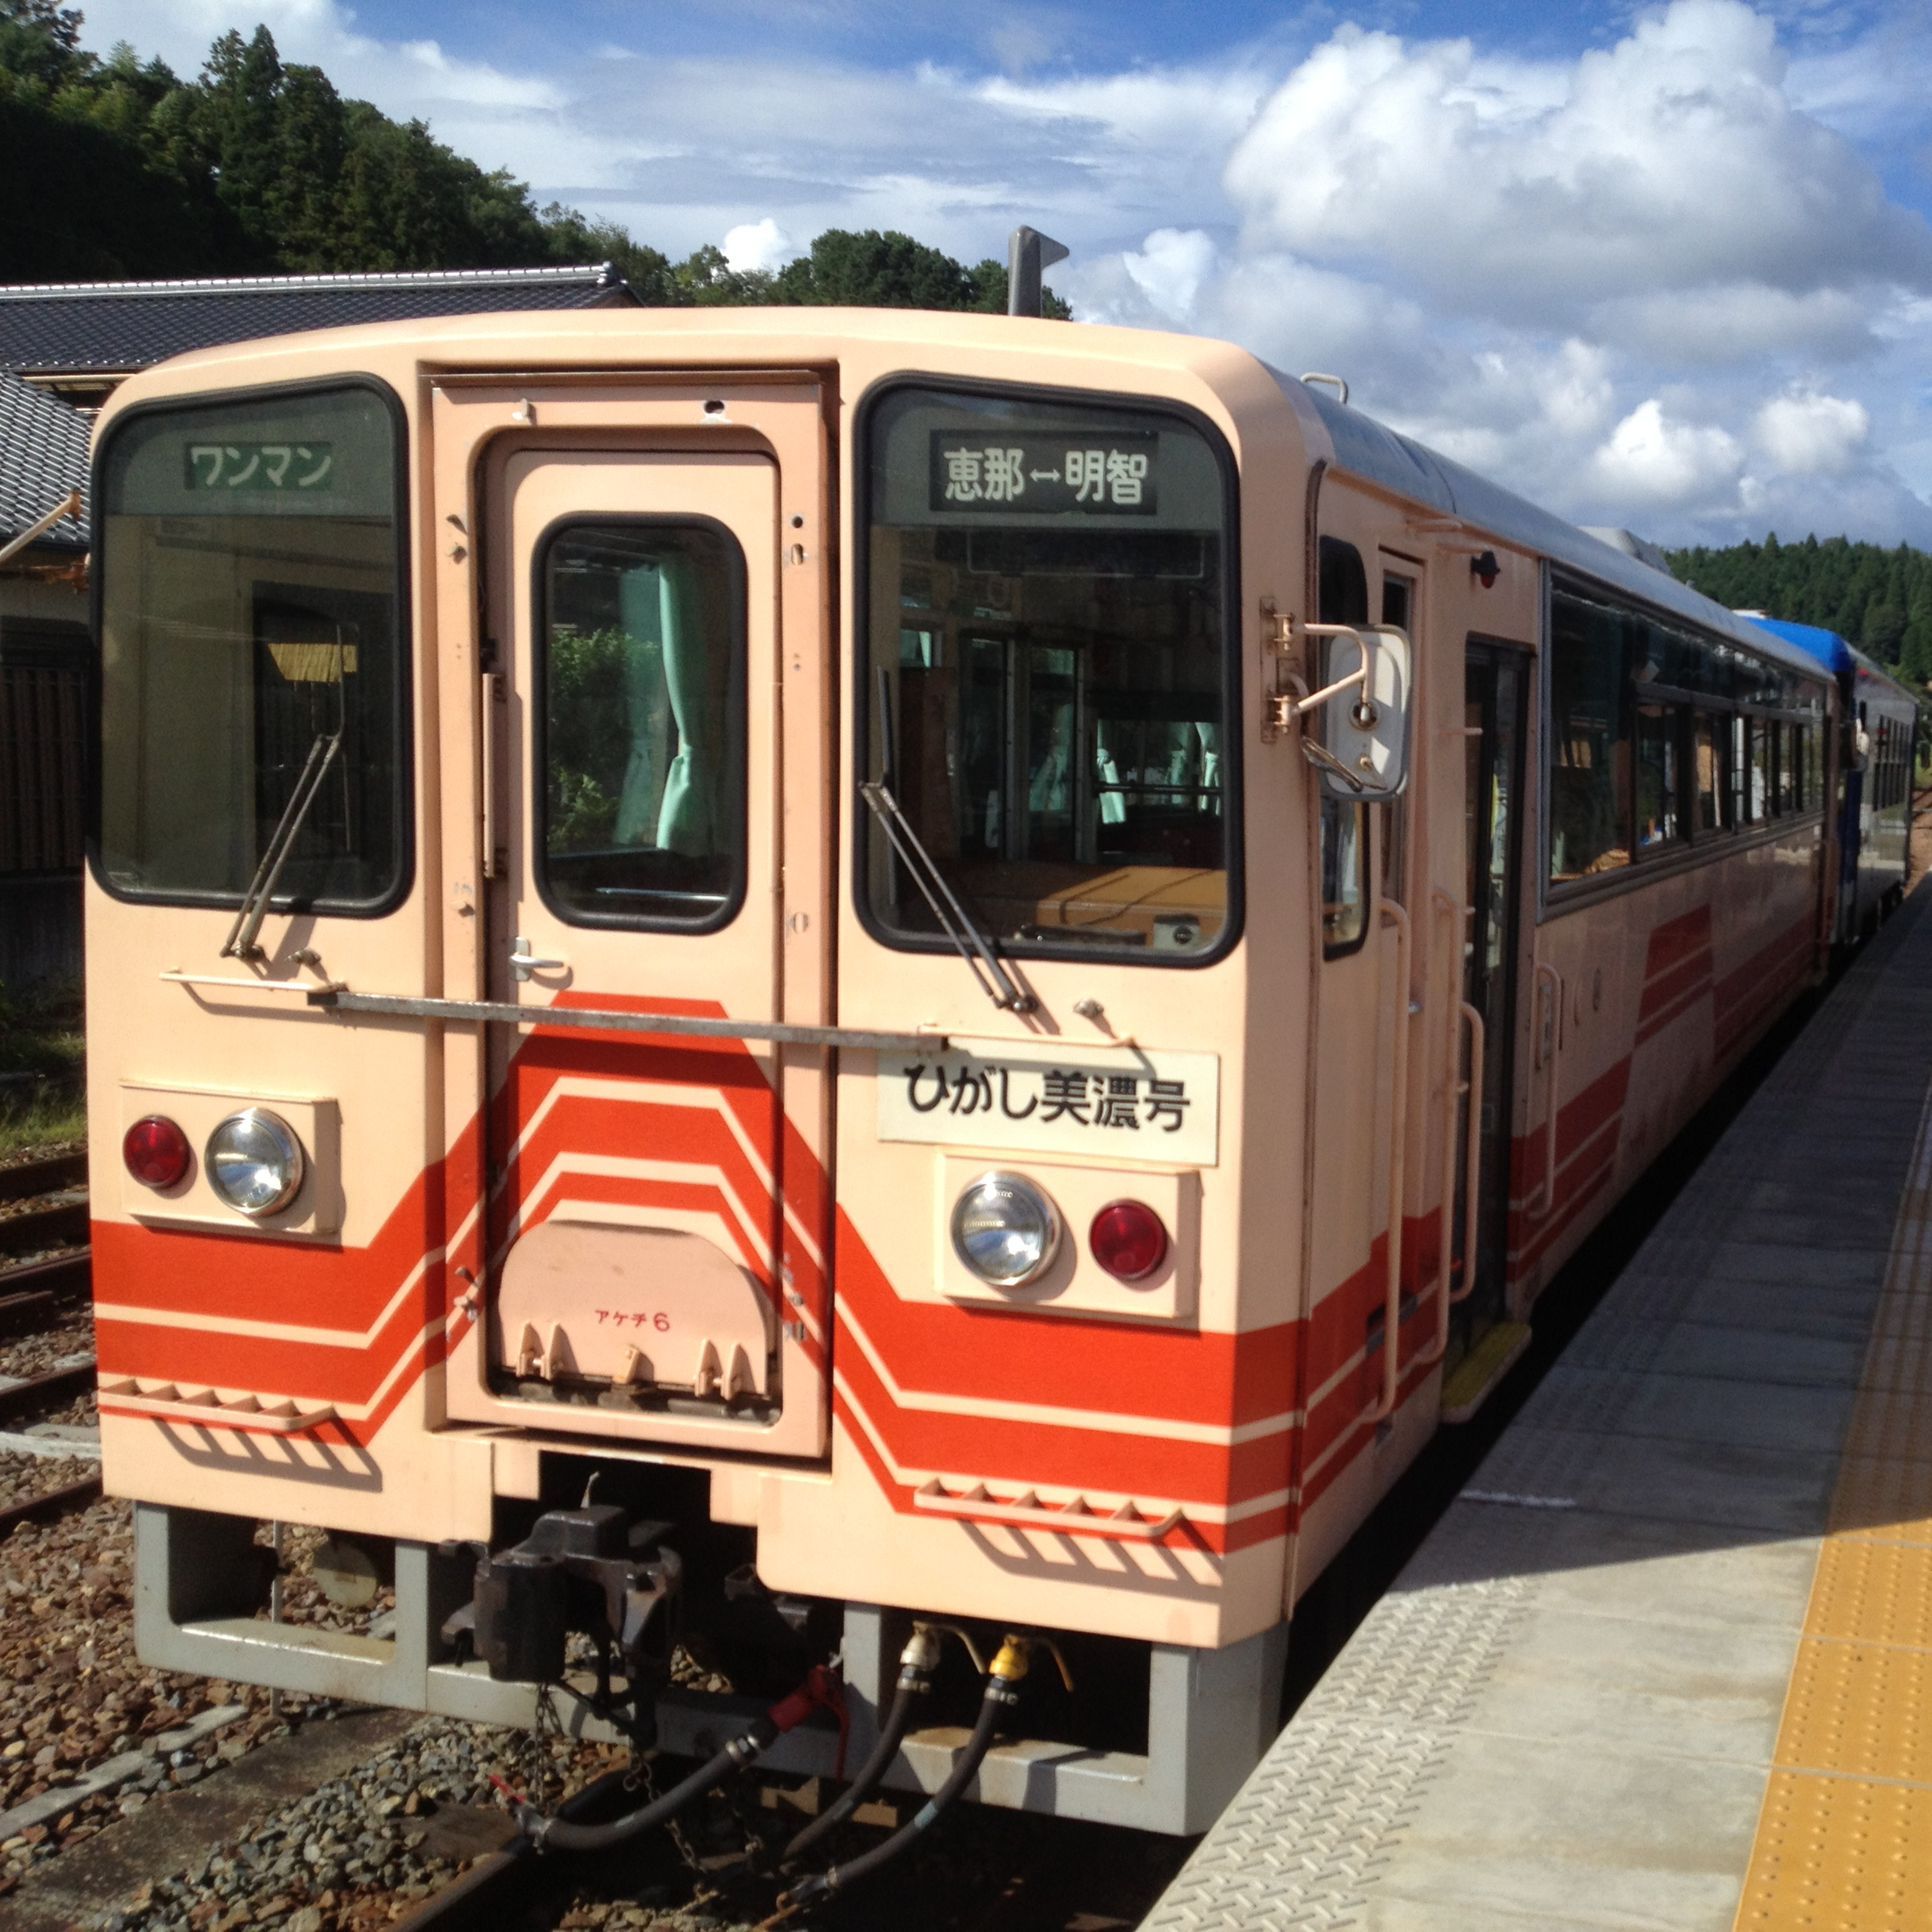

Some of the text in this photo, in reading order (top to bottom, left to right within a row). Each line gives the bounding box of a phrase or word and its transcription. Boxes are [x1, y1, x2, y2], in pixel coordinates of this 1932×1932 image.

[191, 446, 331, 486] ワンマン
[904, 1063, 1191, 1132] ひがし美濃号
